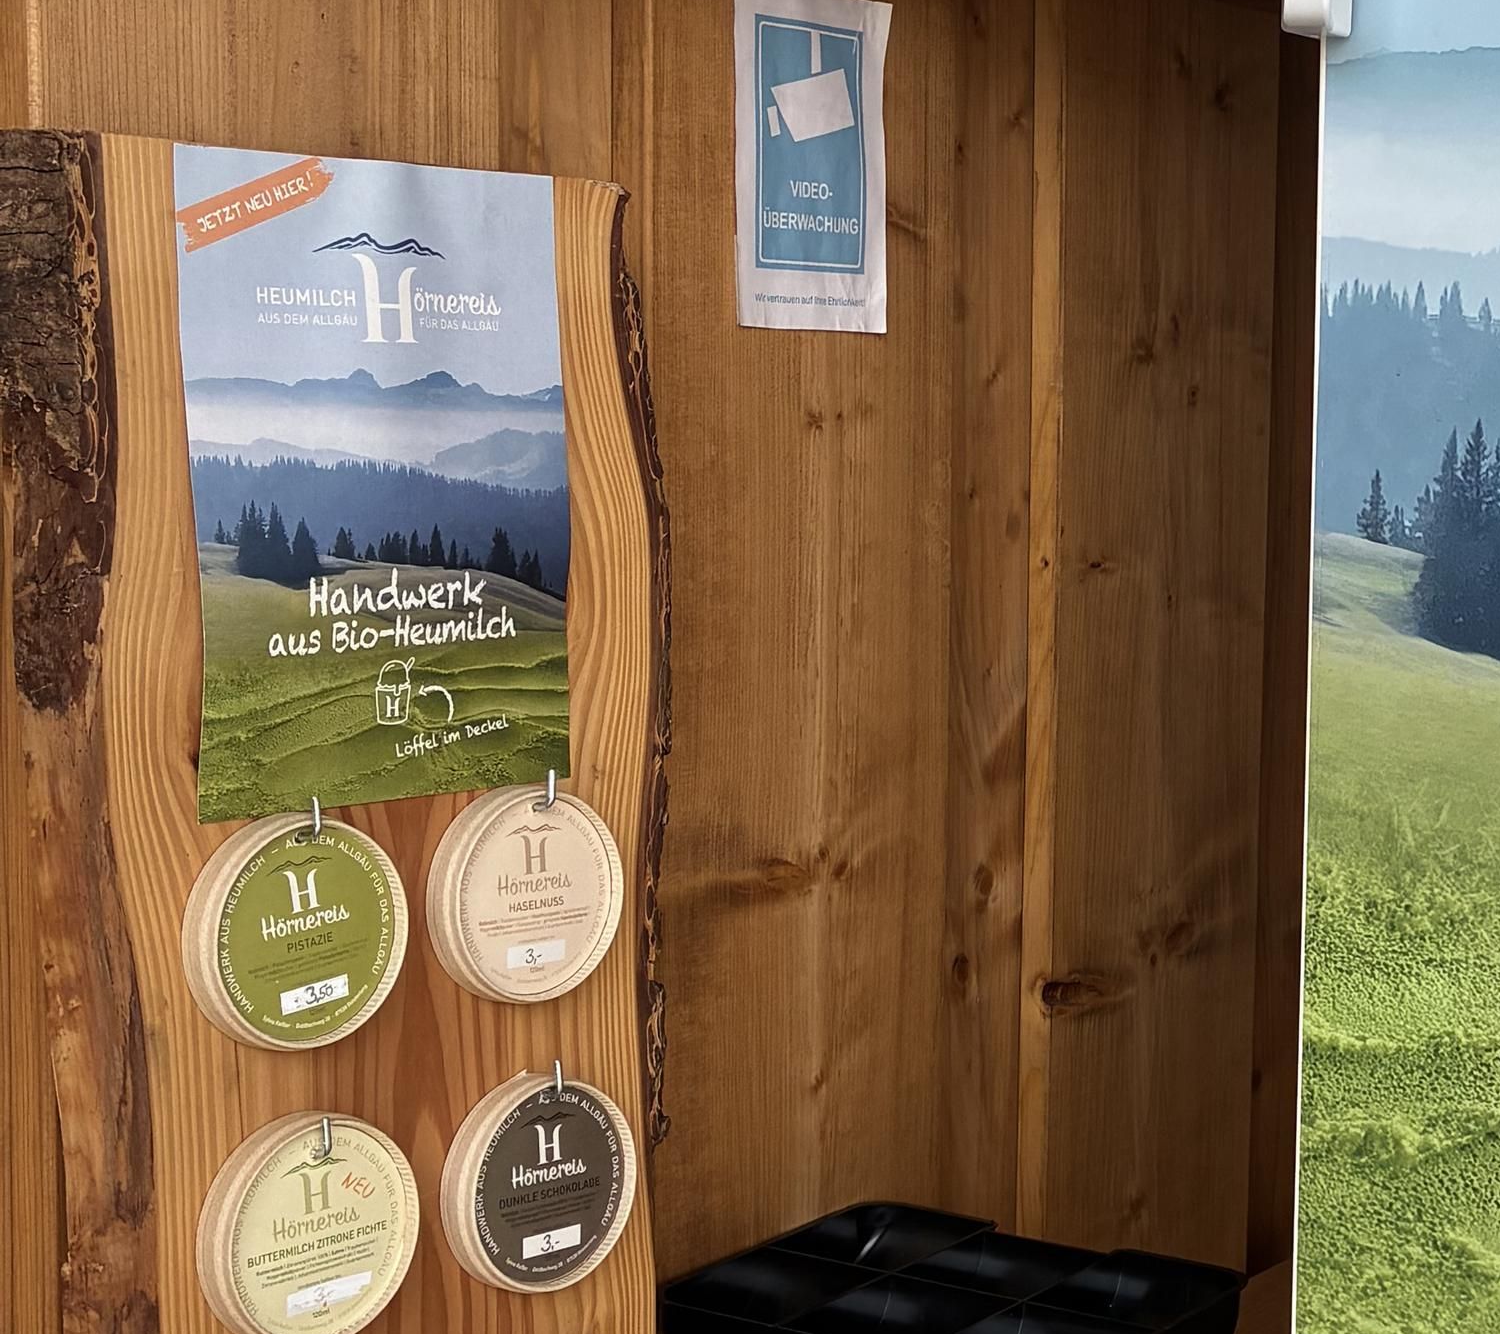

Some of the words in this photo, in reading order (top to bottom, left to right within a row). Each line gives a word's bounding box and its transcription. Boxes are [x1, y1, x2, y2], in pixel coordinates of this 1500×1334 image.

[196, 202, 242, 234] JETZT
[245, 190, 273, 215] NEU
[274, 170, 315, 204] HIER!
[790, 179, 834, 201] VIDEO-
[763, 206, 860, 235] ÜBERWACHUNG
[256, 286, 356, 308] HEUMILCH
[258, 312, 281, 325] AUS
[284, 313, 310, 326] DEM
[312, 310, 358, 327] ALLGÄU
[419, 315, 438, 330] FÜR
[440, 317, 459, 331] DAS
[461, 316, 500, 332] ALLGÄU
[309, 567, 487, 618] Handwerk
[268, 631, 321, 657] aus
[332, 605, 517, 654] Bio-Heumilch
[385, 694, 401, 718] H
[395, 732, 440, 758] Löffel
[443, 728, 462, 745] im
[464, 713, 509, 739] Deckel
[337, 841, 372, 872] ALLGÄU
[227, 855, 266, 914] HEUMILCH
[369, 872, 382, 897] FÜR
[498, 872, 573, 896] Hörnereis
[379, 898, 389, 923] DAS
[508, 896, 565, 914] HASELNUSS
[221, 919, 231, 945] AUS
[261, 903, 350, 942] Hörnereis
[287, 931, 334, 954] PISTAZIE
[371, 926, 389, 976] ALLGÄU
[219, 948, 255, 1014] HANDWERK
[559, 1092, 579, 1105] DEM
[606, 1130, 619, 1153] FÜR
[340, 1171, 376, 1200] NEU
[476, 1165, 488, 1190] AUS
[511, 1158, 587, 1190] Hörnereis
[498, 1192, 539, 1211] DUNKLE
[539, 1177, 601, 1200] SCHOKOLADE
[272, 1207, 361, 1243] Hörnereis
[475, 1193, 501, 1256] HANDWERK
[247, 1239, 315, 1269] BUTTERMILCH
[316, 1228, 356, 1250] ZITRONE
[356, 1219, 388, 1238] FICHTE
[540, 1233, 560, 1252] 3,-
